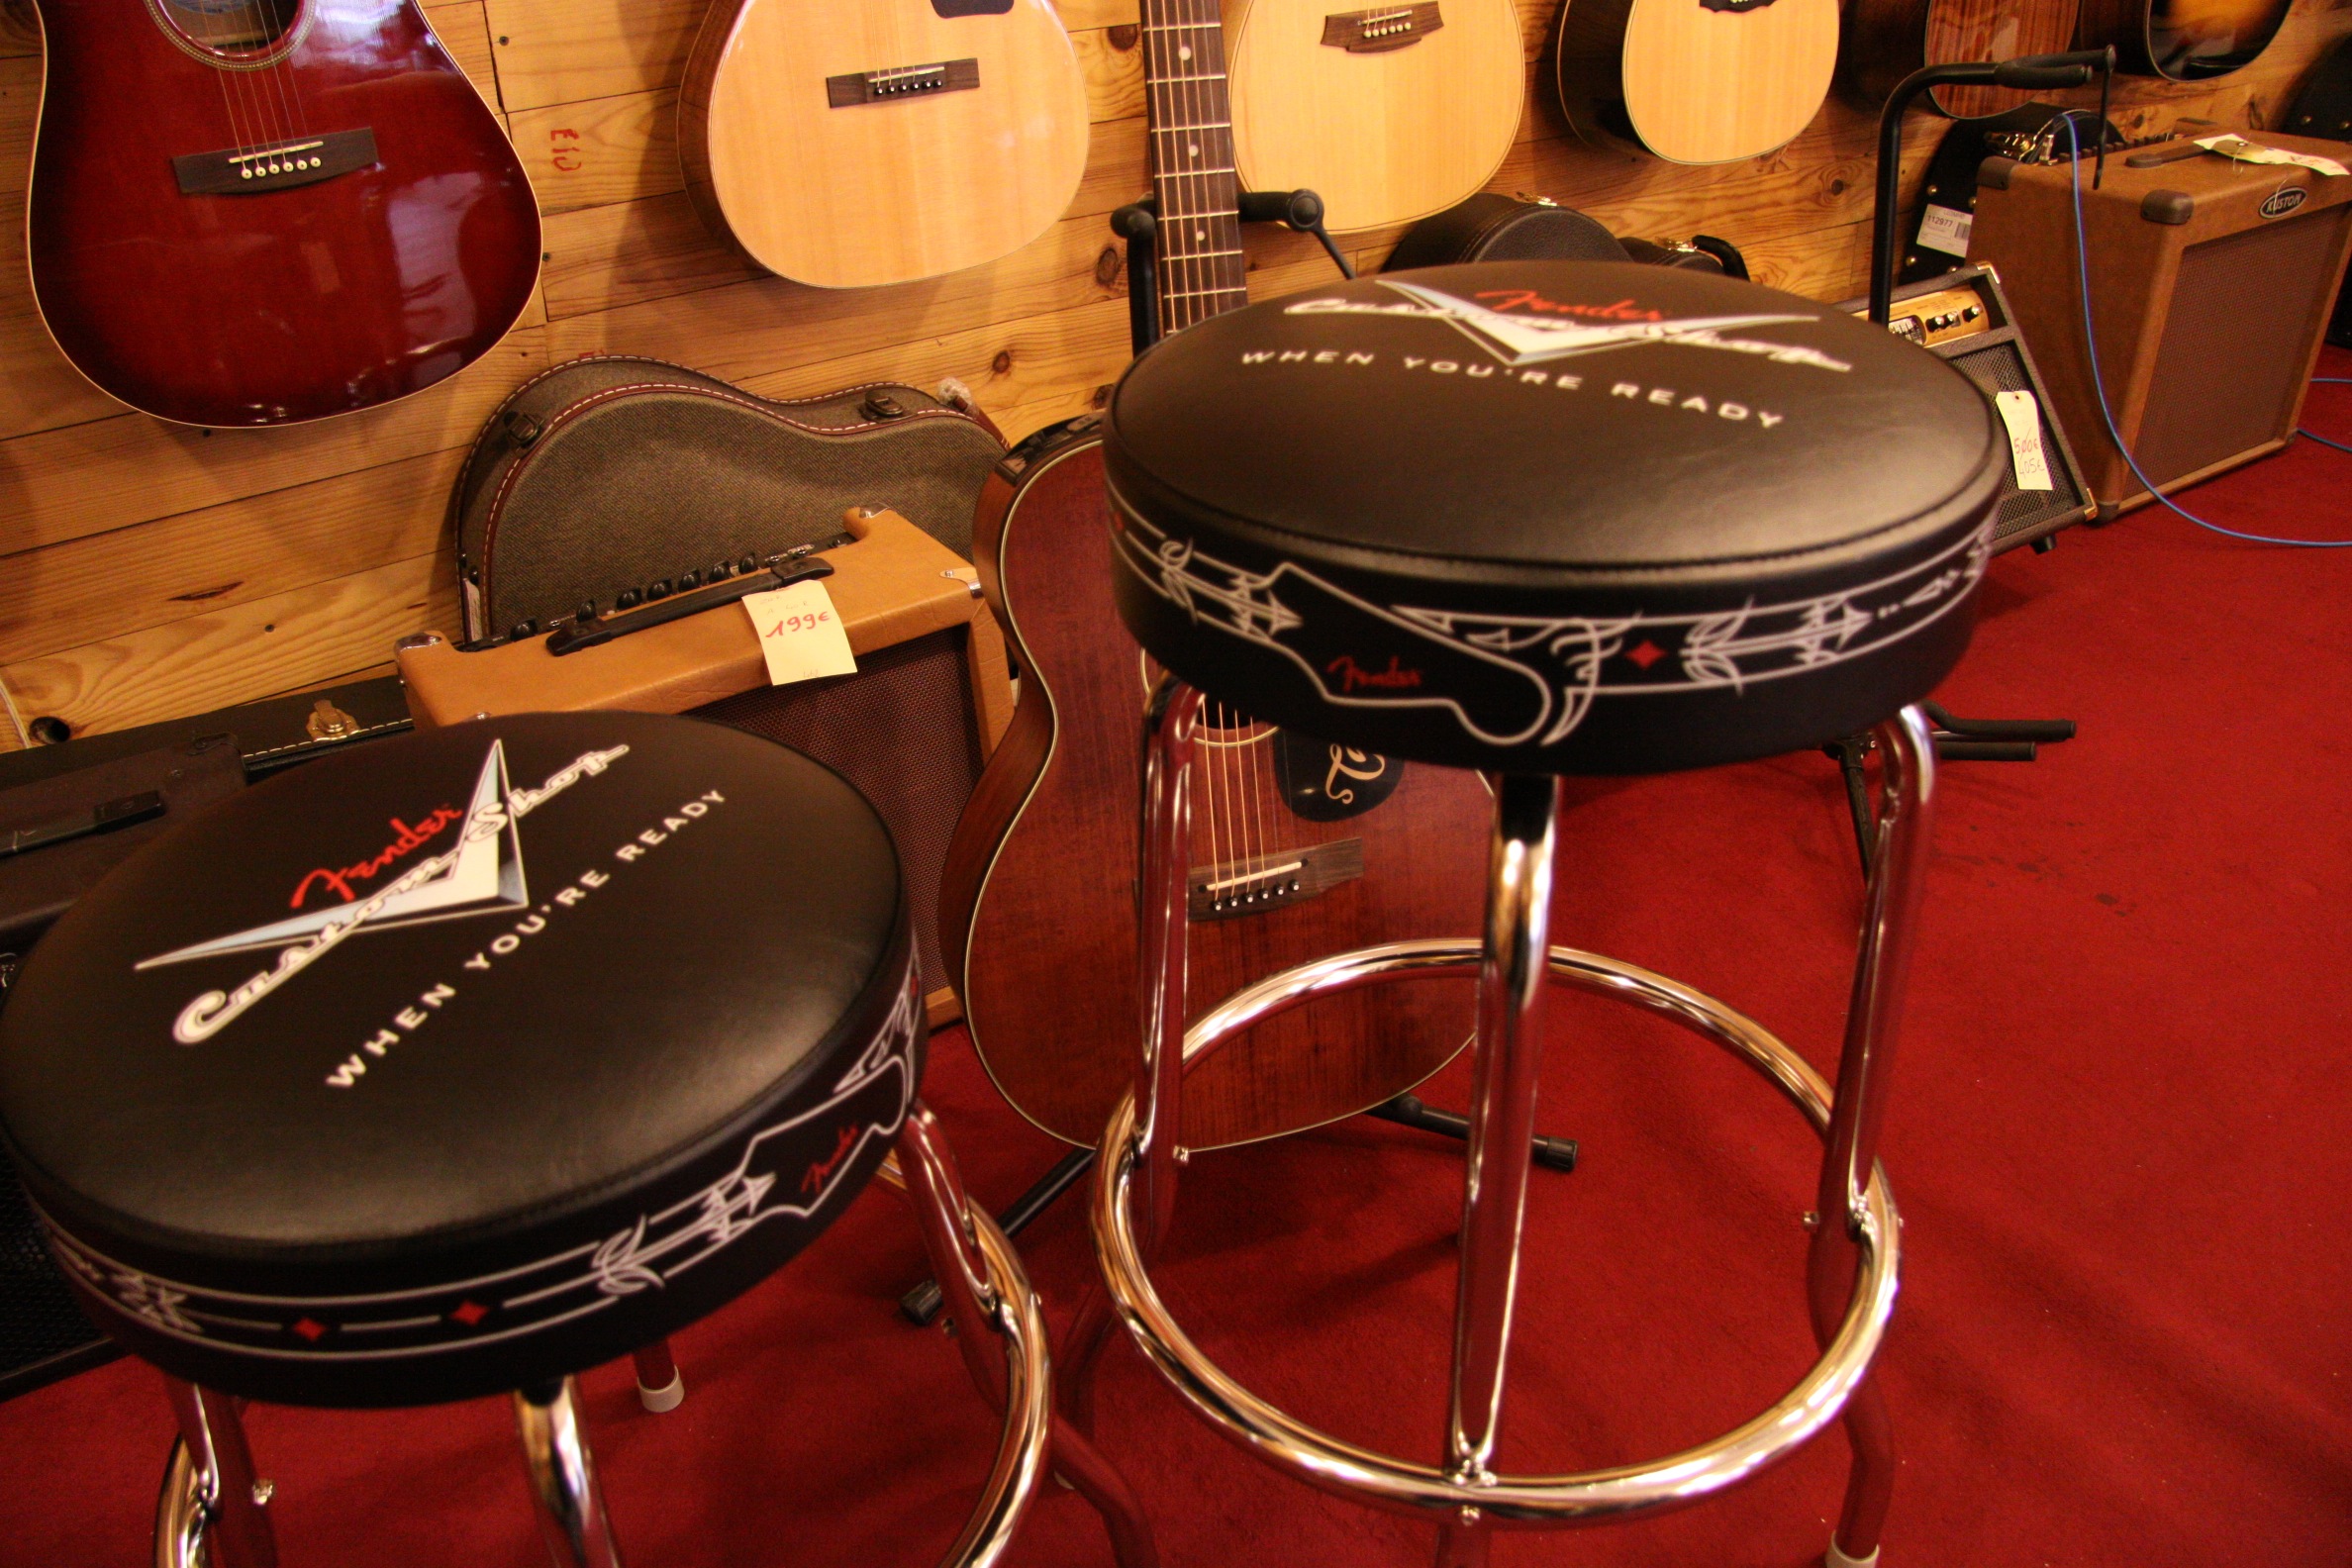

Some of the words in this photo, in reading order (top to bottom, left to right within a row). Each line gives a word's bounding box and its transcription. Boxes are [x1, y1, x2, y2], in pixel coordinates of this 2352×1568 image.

[1475, 289, 1662, 322] Fender
[1241, 349, 1376, 365] WHEN
[1402, 355, 1584, 391] YOU'RE
[1610, 381, 1784, 430] READY
[765, 611, 831, 638] 199€
[172, 845, 459, 1044] Custom
[465, 743, 630, 843] Shop
[290, 804, 463, 909] Fender
[325, 983, 457, 1087] WHEN
[463, 869, 611, 970] YOU'RE
[615, 790, 726, 862] READY
